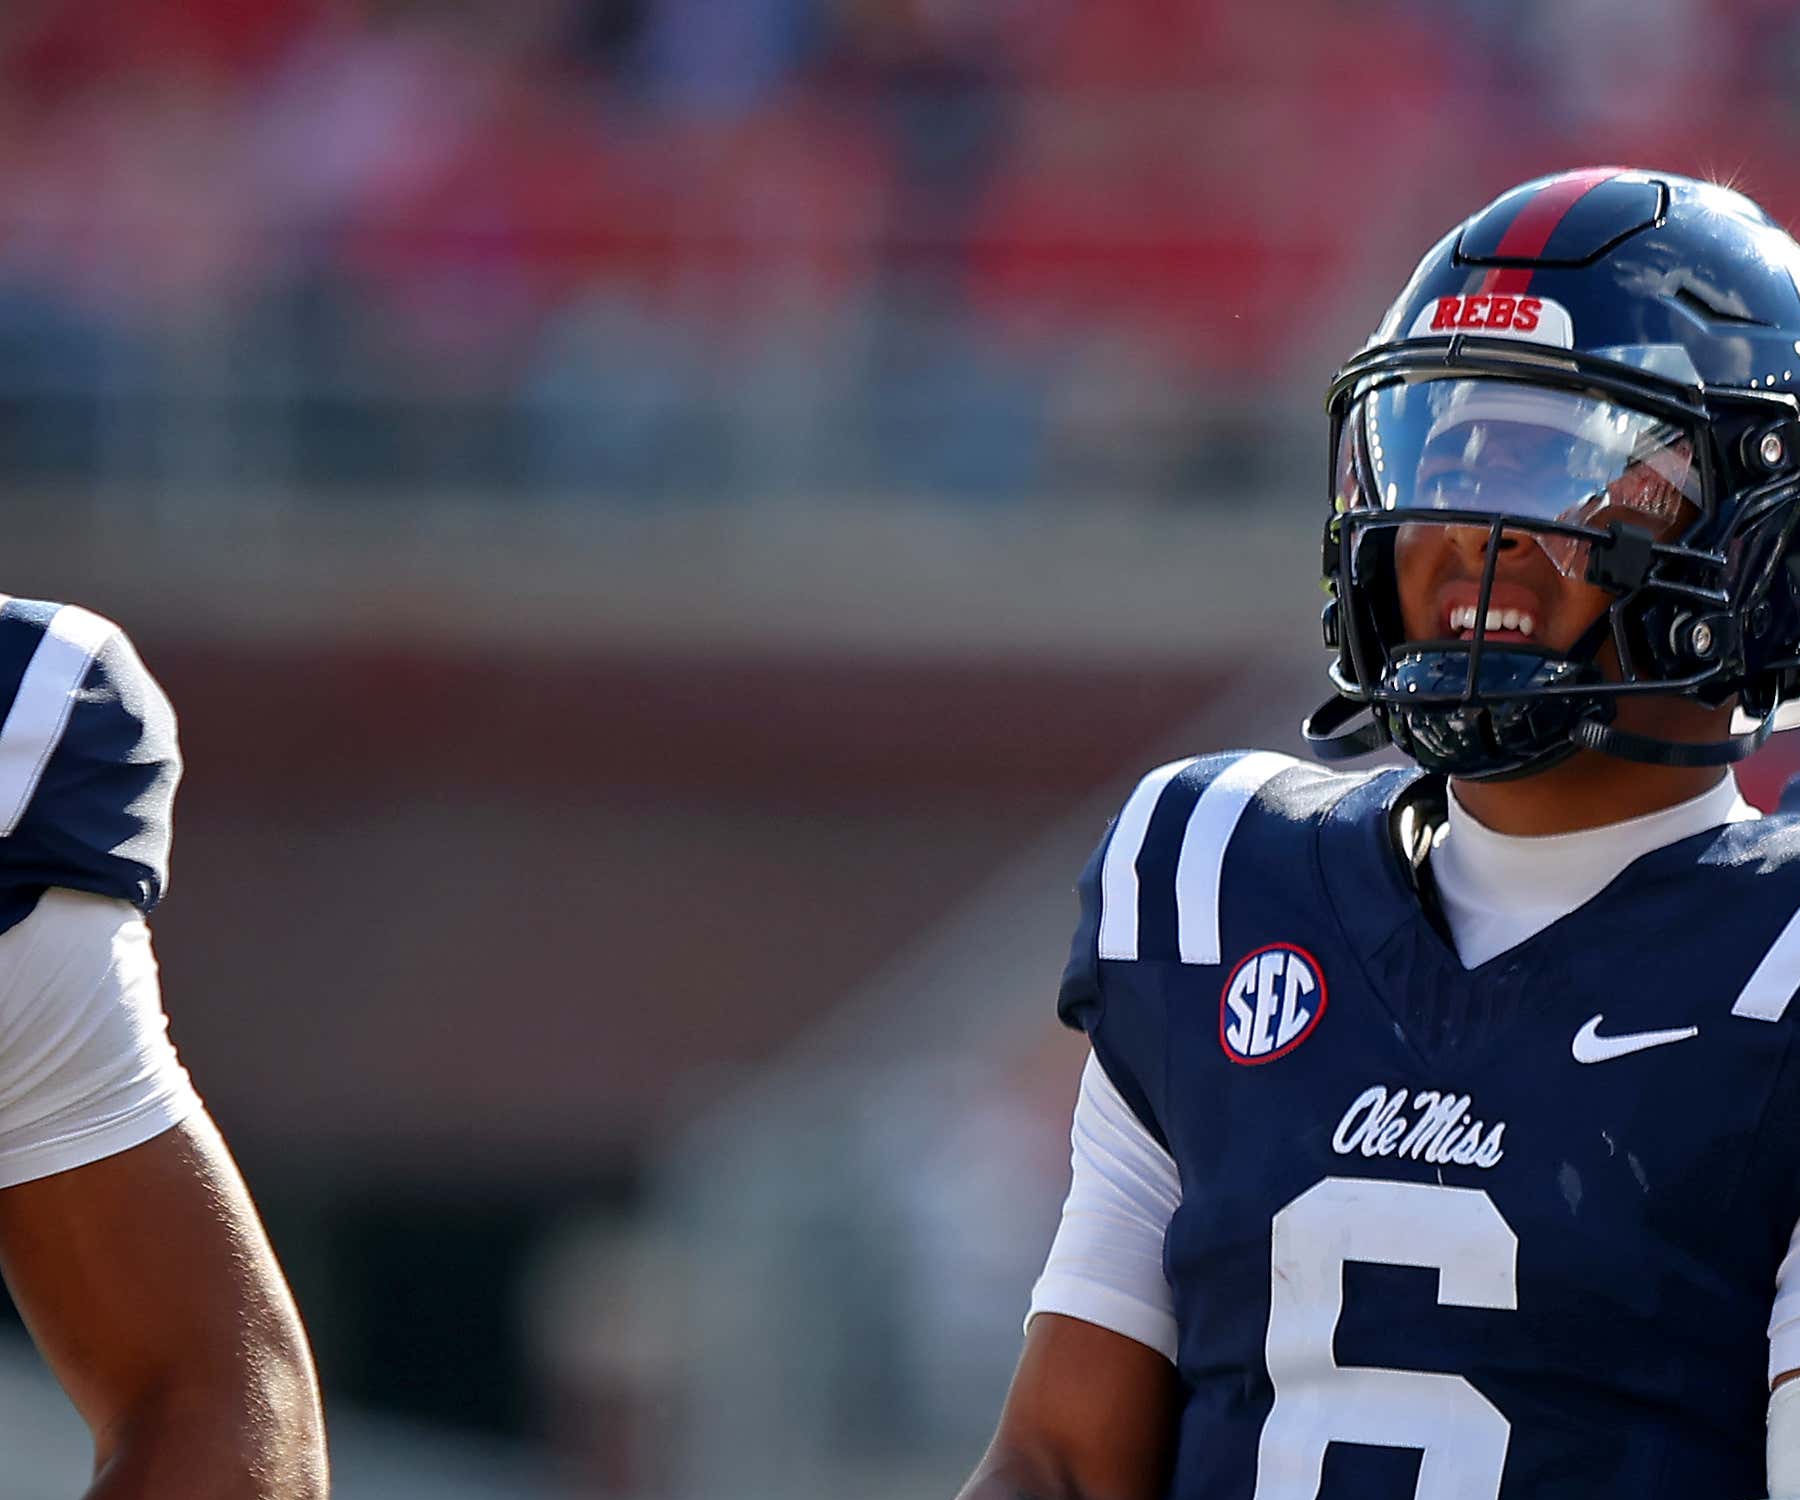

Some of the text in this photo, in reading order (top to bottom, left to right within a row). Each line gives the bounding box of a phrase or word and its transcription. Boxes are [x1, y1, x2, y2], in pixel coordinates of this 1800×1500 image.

[1430, 296, 1543, 332] REBS
[1226, 949, 1316, 1058] SEC
[1332, 1085, 1506, 1168] Ole Miss
